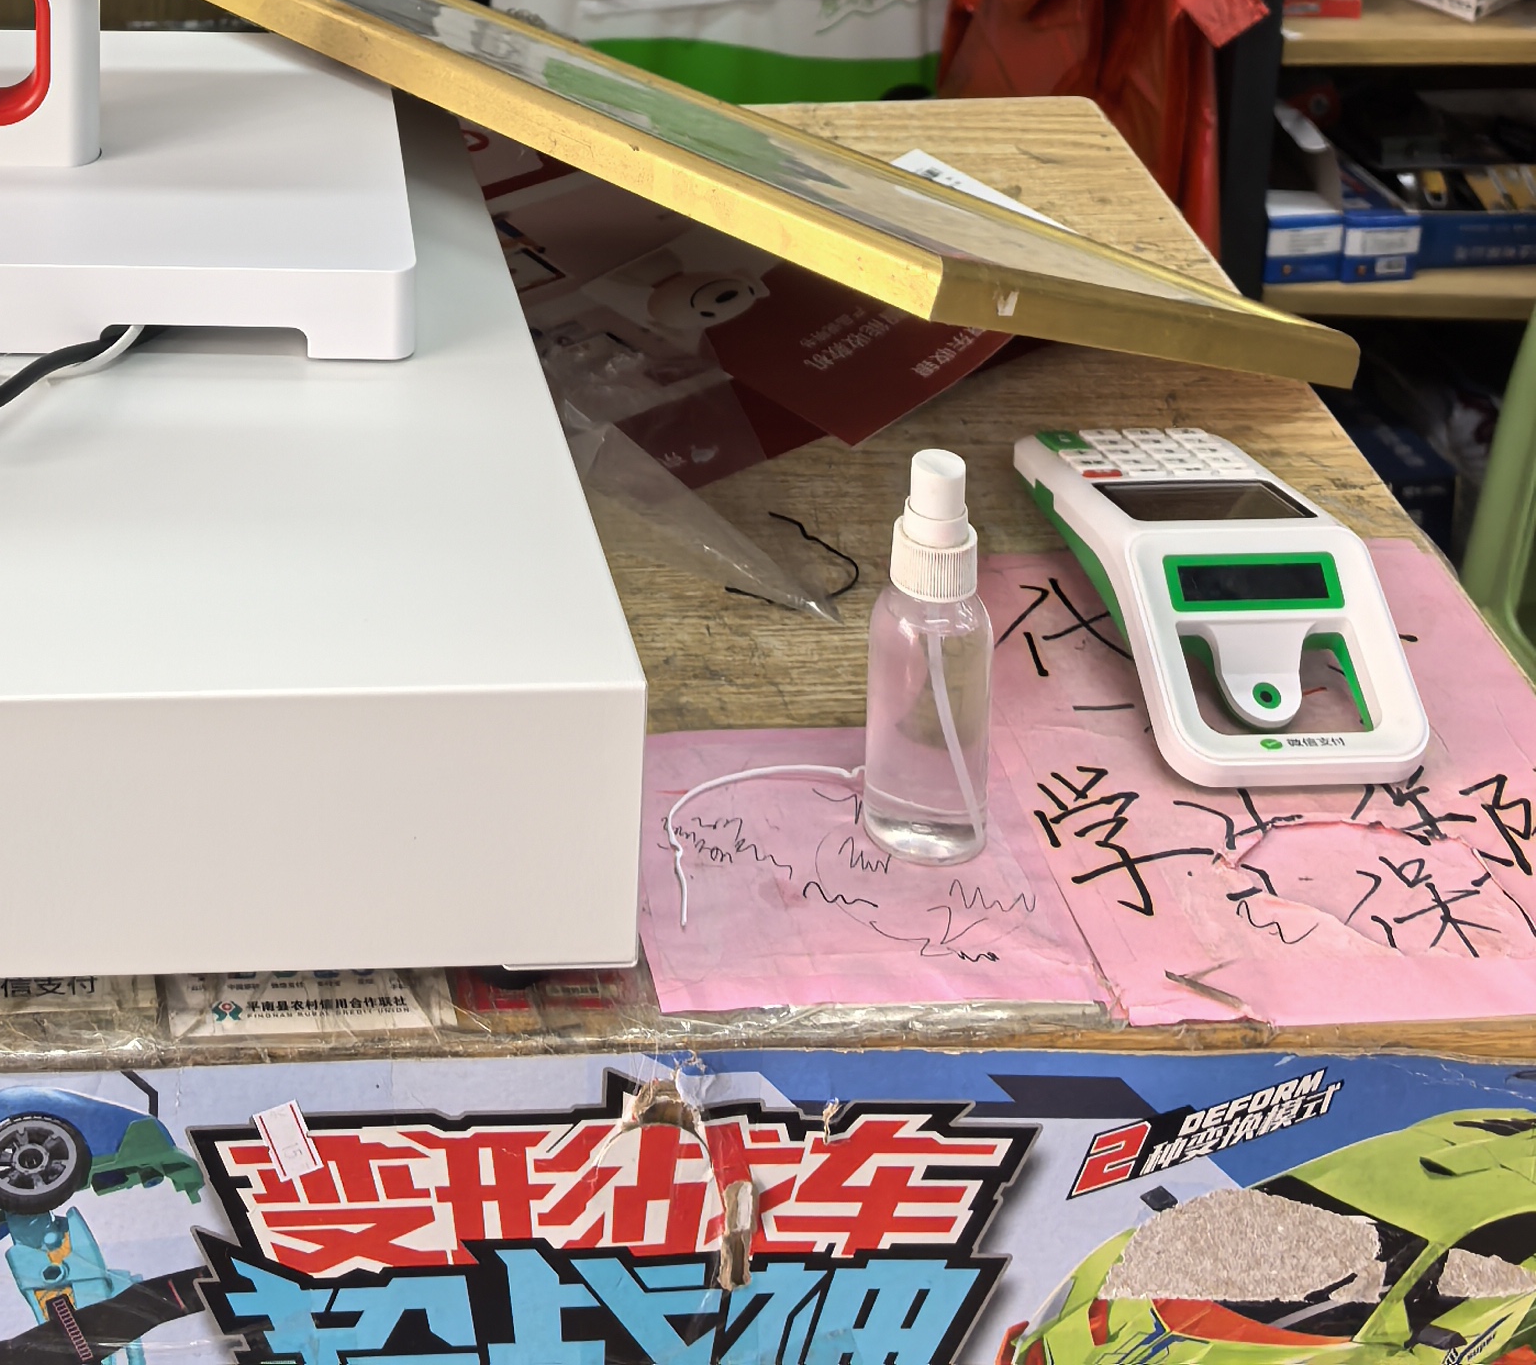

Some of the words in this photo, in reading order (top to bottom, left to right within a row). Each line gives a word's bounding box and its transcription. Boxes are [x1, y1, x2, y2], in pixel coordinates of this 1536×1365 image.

[1286, 736, 1346, 748] 微信支付
[246, 996, 408, 1012] 平南县农村信用合作联社
[1140, 1082, 1343, 1176] 种变换模式
[1178, 1067, 1329, 1136] DEFORM
[1070, 1120, 1152, 1199] 2
